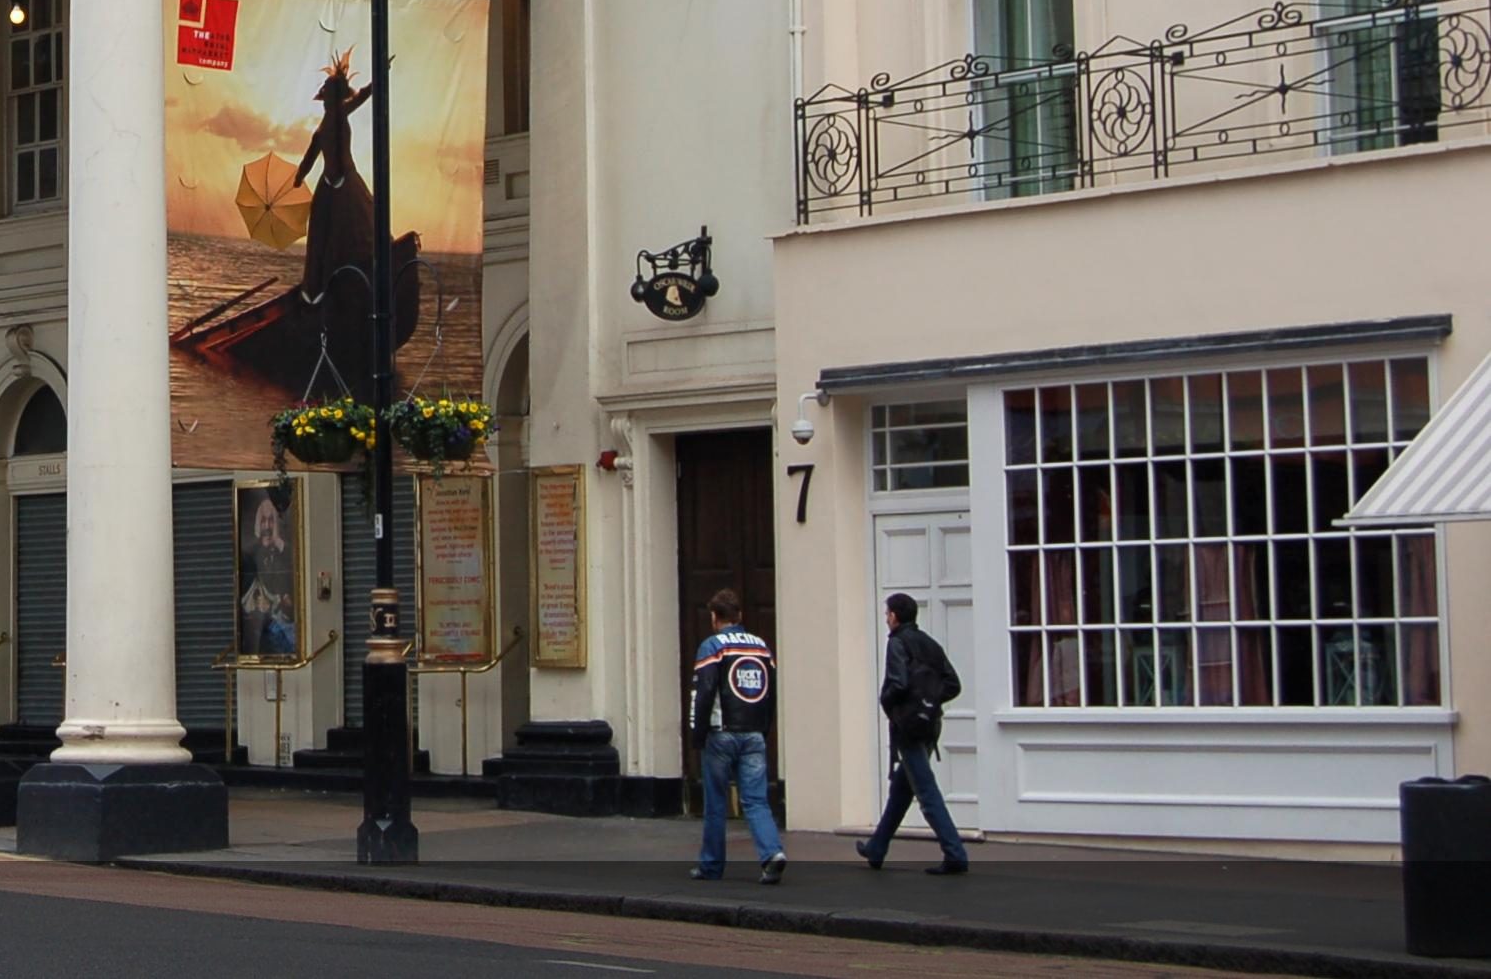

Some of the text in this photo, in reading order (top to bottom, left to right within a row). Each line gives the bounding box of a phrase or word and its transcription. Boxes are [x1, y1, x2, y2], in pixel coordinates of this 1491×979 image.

[38, 463, 61, 477] STALLS
[787, 464, 815, 524] 7
[736, 668, 762, 680] LUCKY
